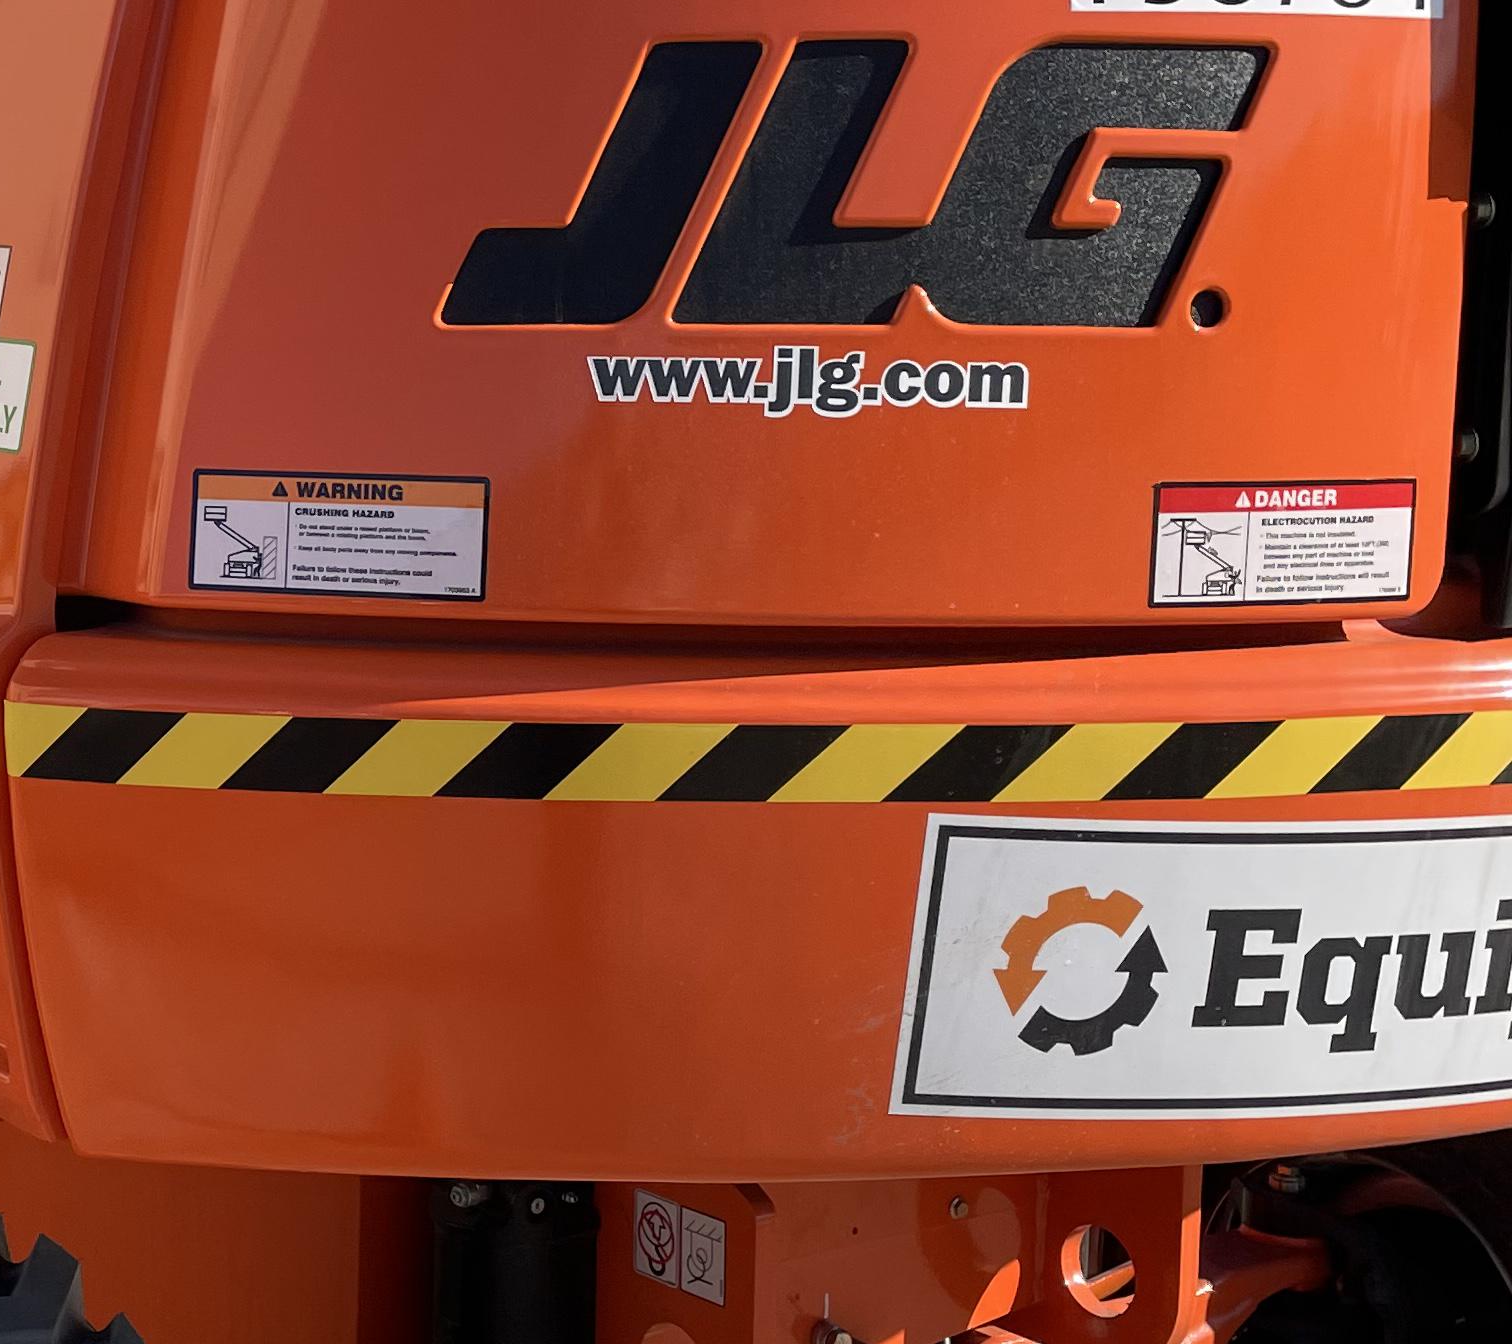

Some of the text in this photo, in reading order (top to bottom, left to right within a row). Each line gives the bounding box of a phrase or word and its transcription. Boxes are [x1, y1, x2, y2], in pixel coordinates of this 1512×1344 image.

[438, 38, 1274, 330] JLG
[589, 346, 1028, 416] www.jlg.com
[296, 481, 404, 501] WARNING
[1254, 489, 1338, 508] DANGER
[295, 507, 395, 519] CRUSHING HAZARD
[1262, 517, 1336, 526] ELECTROCUTION
[1191, 898, 1512, 1054] Equi
